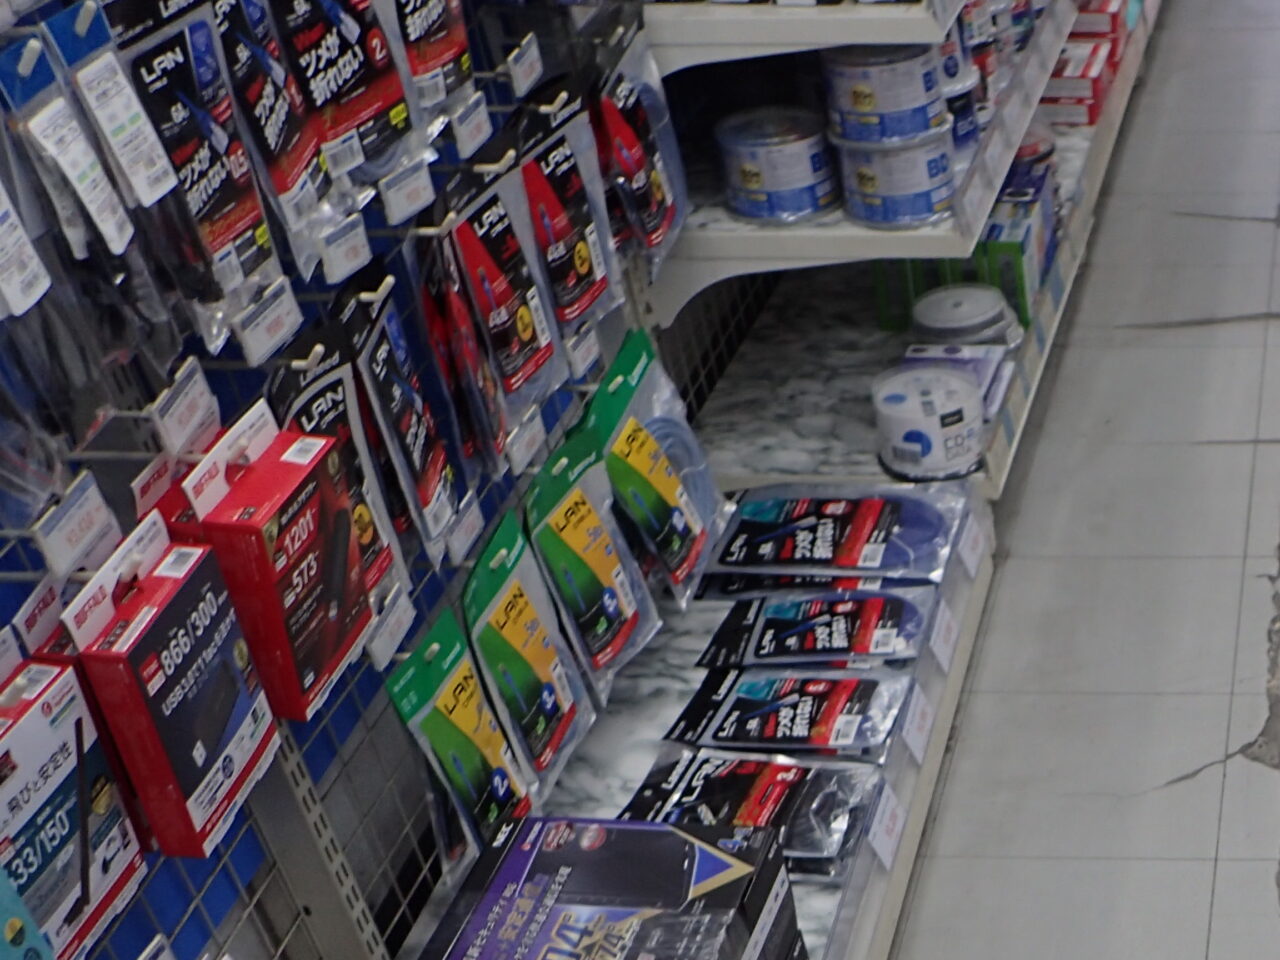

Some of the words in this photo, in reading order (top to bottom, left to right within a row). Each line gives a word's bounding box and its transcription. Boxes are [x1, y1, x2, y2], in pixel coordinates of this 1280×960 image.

[140, 46, 185, 84] LAN
[473, 201, 506, 237] LAN
[301, 385, 344, 433] LAN
[284, 510, 316, 557] 1201
[555, 495, 588, 534] LAN
[292, 551, 319, 595] 573
[496, 586, 525, 631] LAN
[160, 591, 218, 677] 866/300
[443, 667, 475, 716] LAN
[8, 808, 71, 886] 33/150
